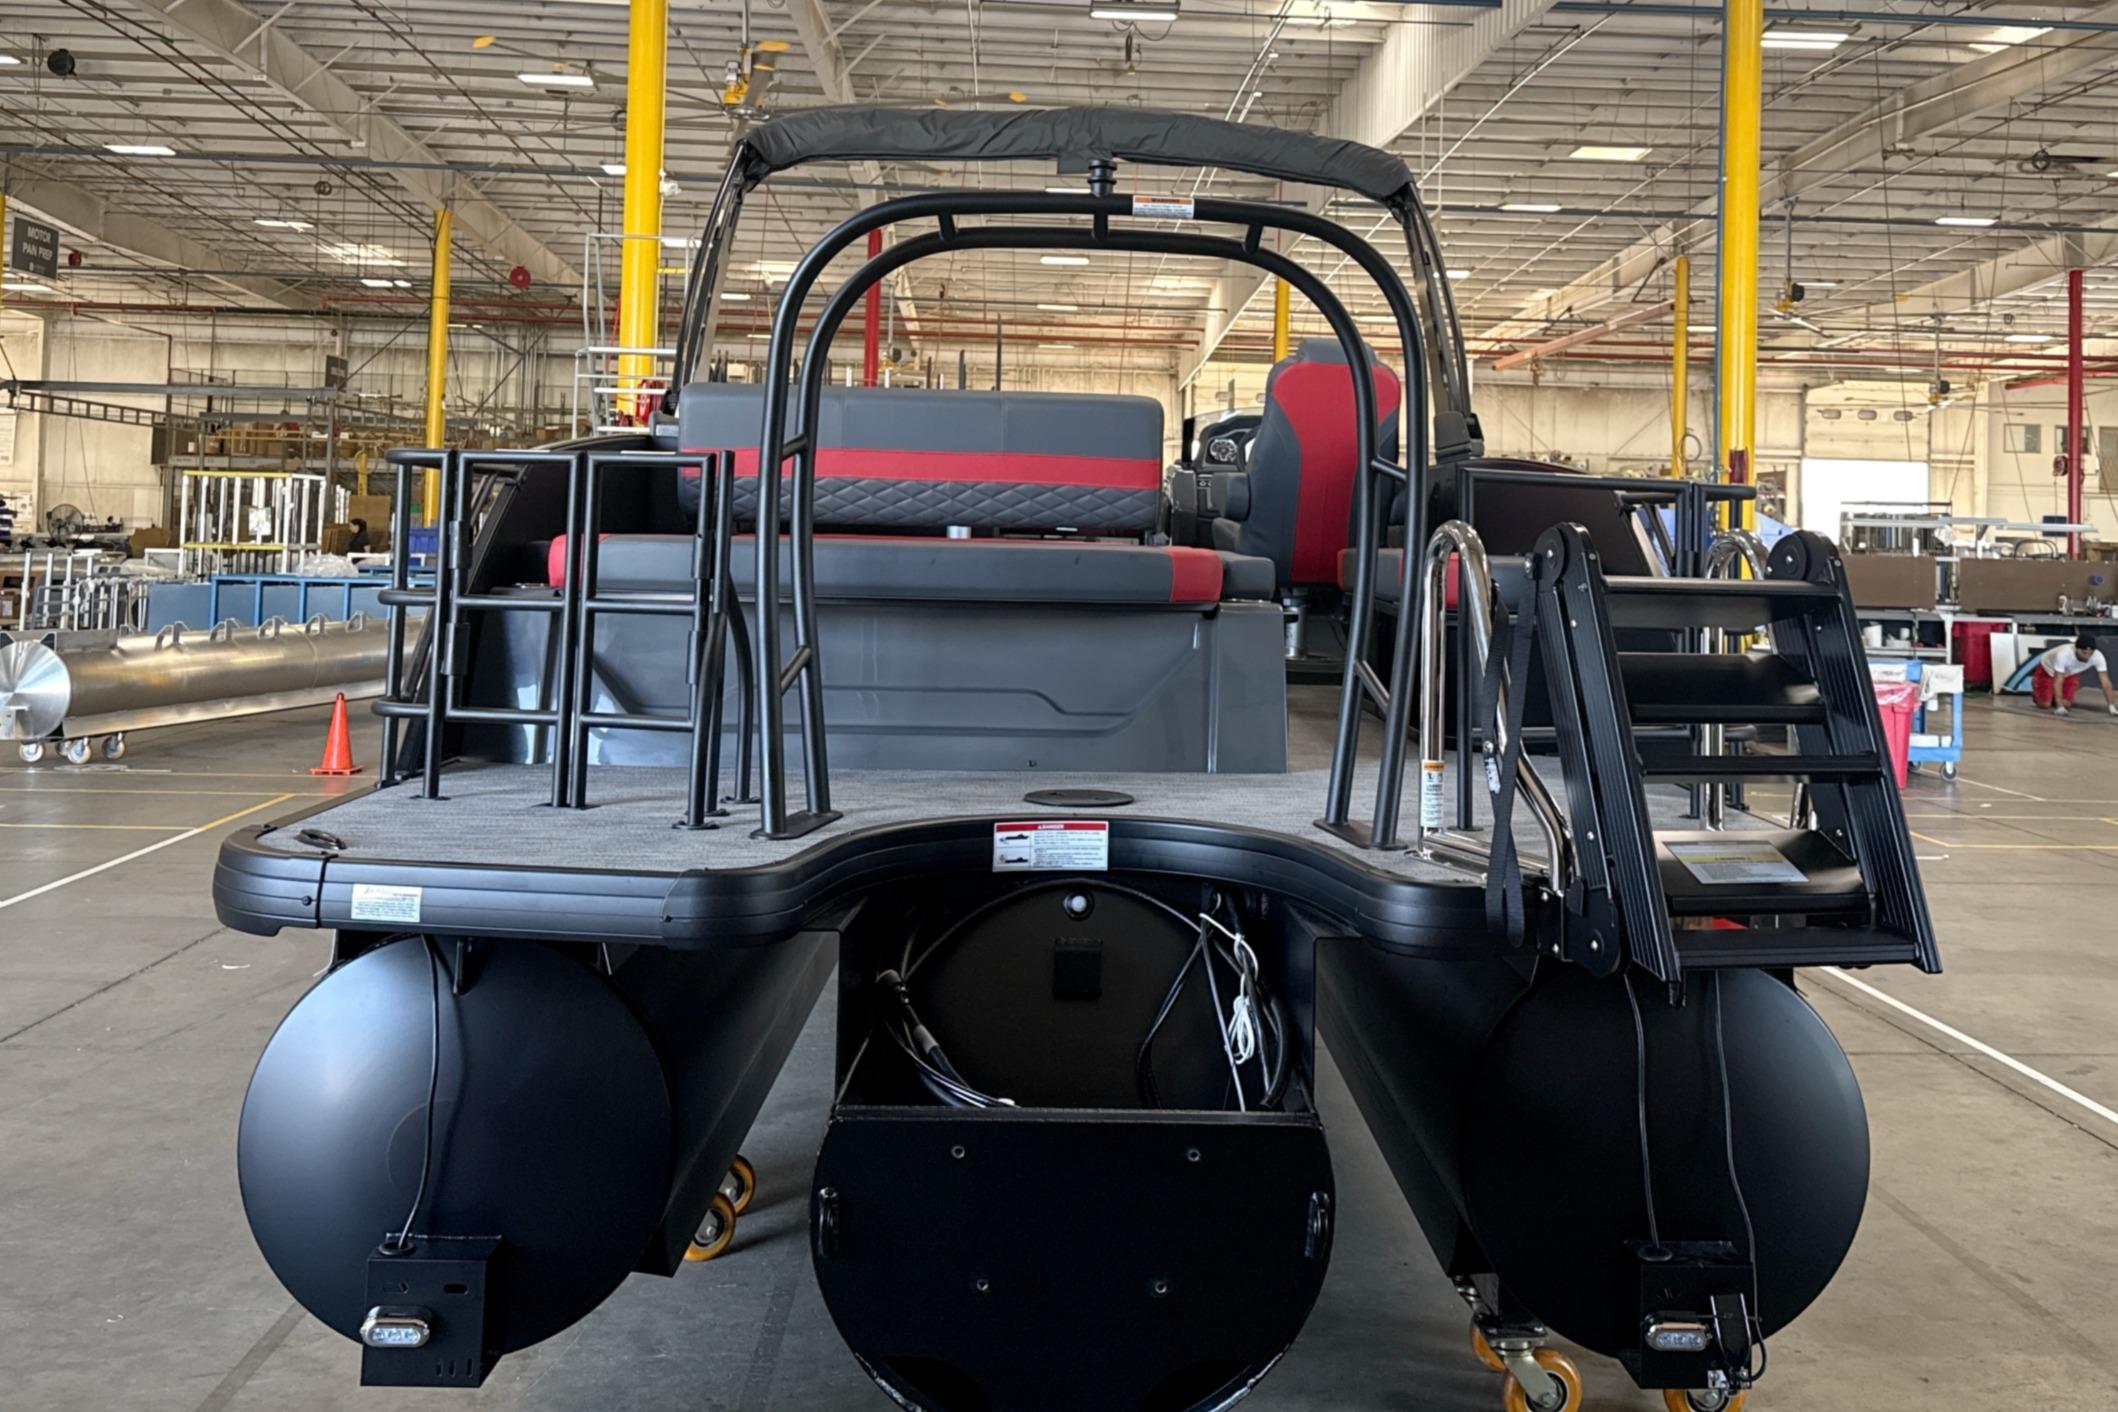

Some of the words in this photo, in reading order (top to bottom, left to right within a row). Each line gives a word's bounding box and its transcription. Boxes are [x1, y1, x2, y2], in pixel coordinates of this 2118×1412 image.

[27, 226, 51, 243] MOTOR
[22, 241, 38, 257] PAN
[39, 246, 53, 261] PREP
